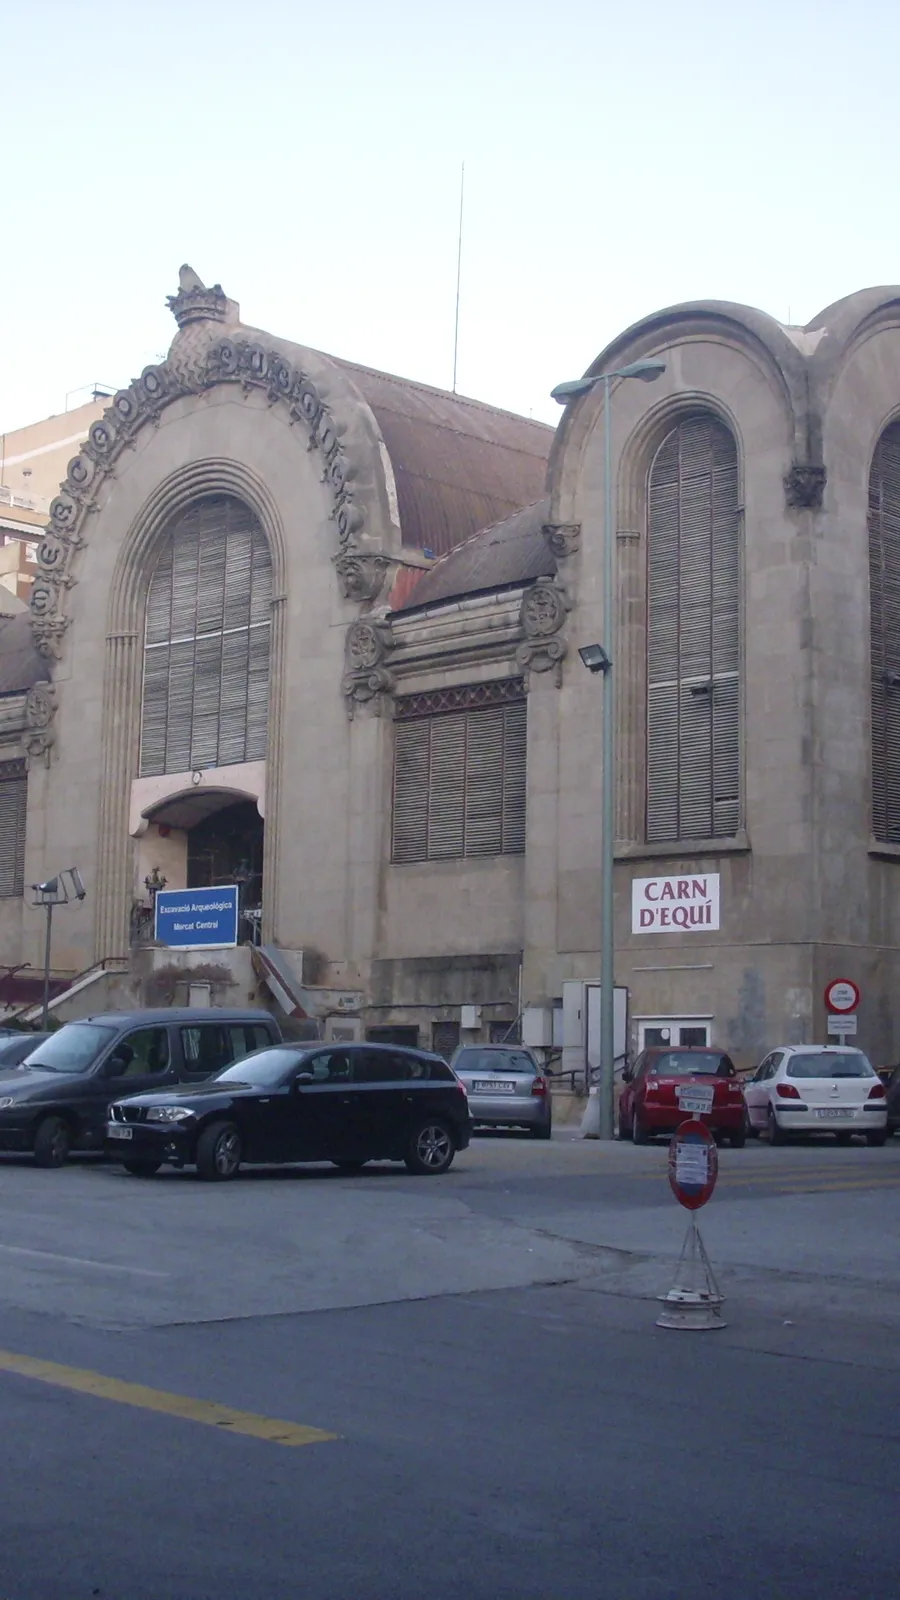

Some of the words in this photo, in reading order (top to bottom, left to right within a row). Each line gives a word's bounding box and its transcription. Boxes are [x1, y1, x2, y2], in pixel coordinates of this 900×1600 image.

[644, 879, 708, 901] CARN
[160, 905, 190, 914] Excavació
[191, 902, 232, 912] Arqueològica
[639, 899, 712, 930] D'EQUÍ
[174, 922, 194, 931] Mercat
[195, 920, 218, 930] Central
